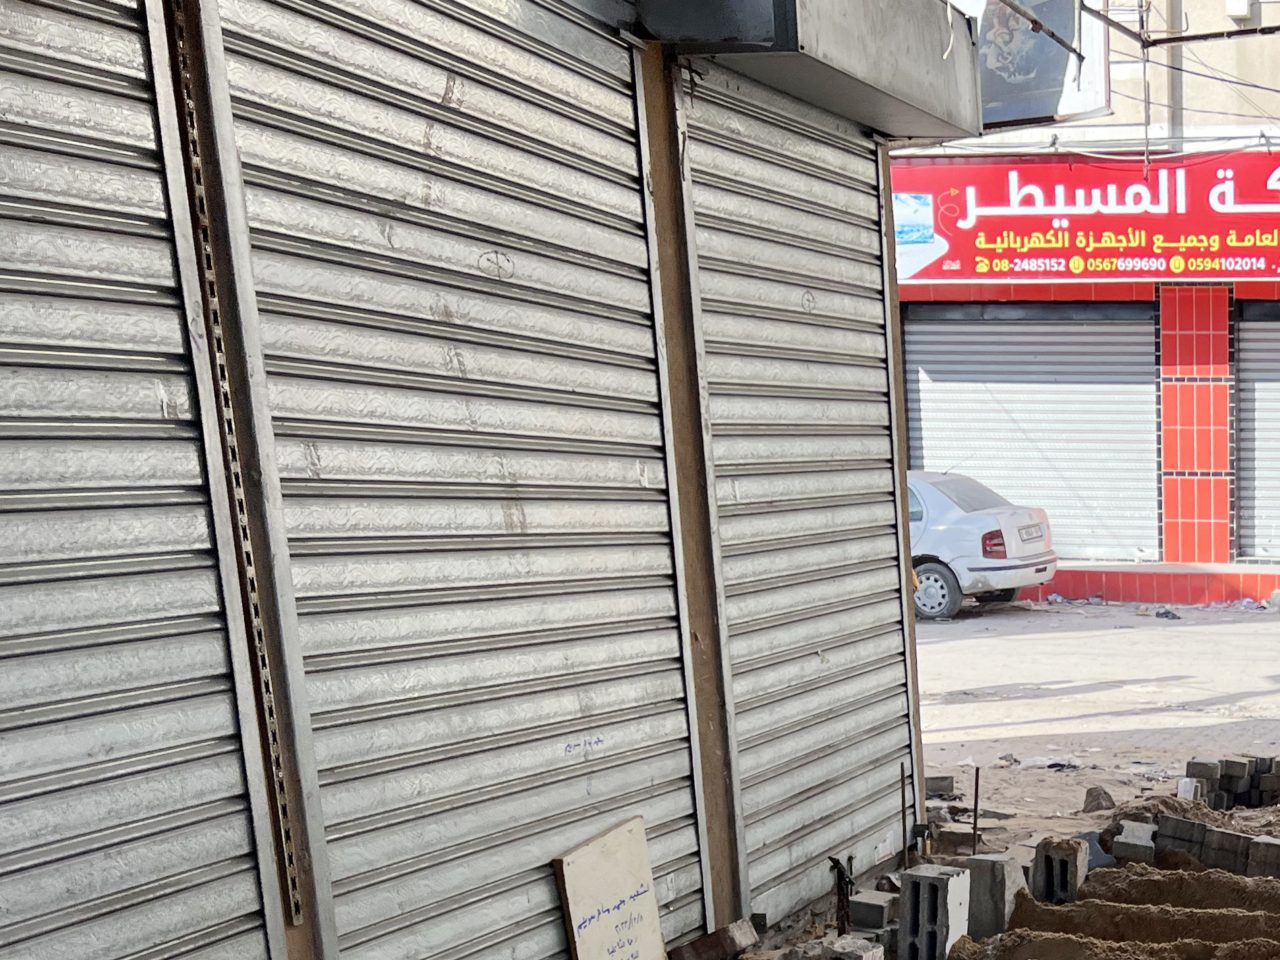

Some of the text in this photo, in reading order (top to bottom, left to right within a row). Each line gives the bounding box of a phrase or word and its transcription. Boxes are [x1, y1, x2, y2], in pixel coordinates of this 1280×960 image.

[955, 168, 1187, 229] المسيطر
[975, 229, 1069, 253] الكهربائية
[1075, 227, 1146, 252] الأجهزة
[1152, 233, 1220, 254] وجميع
[992, 257, 1266, 272] 08-2485152 0567699690 0594102014
